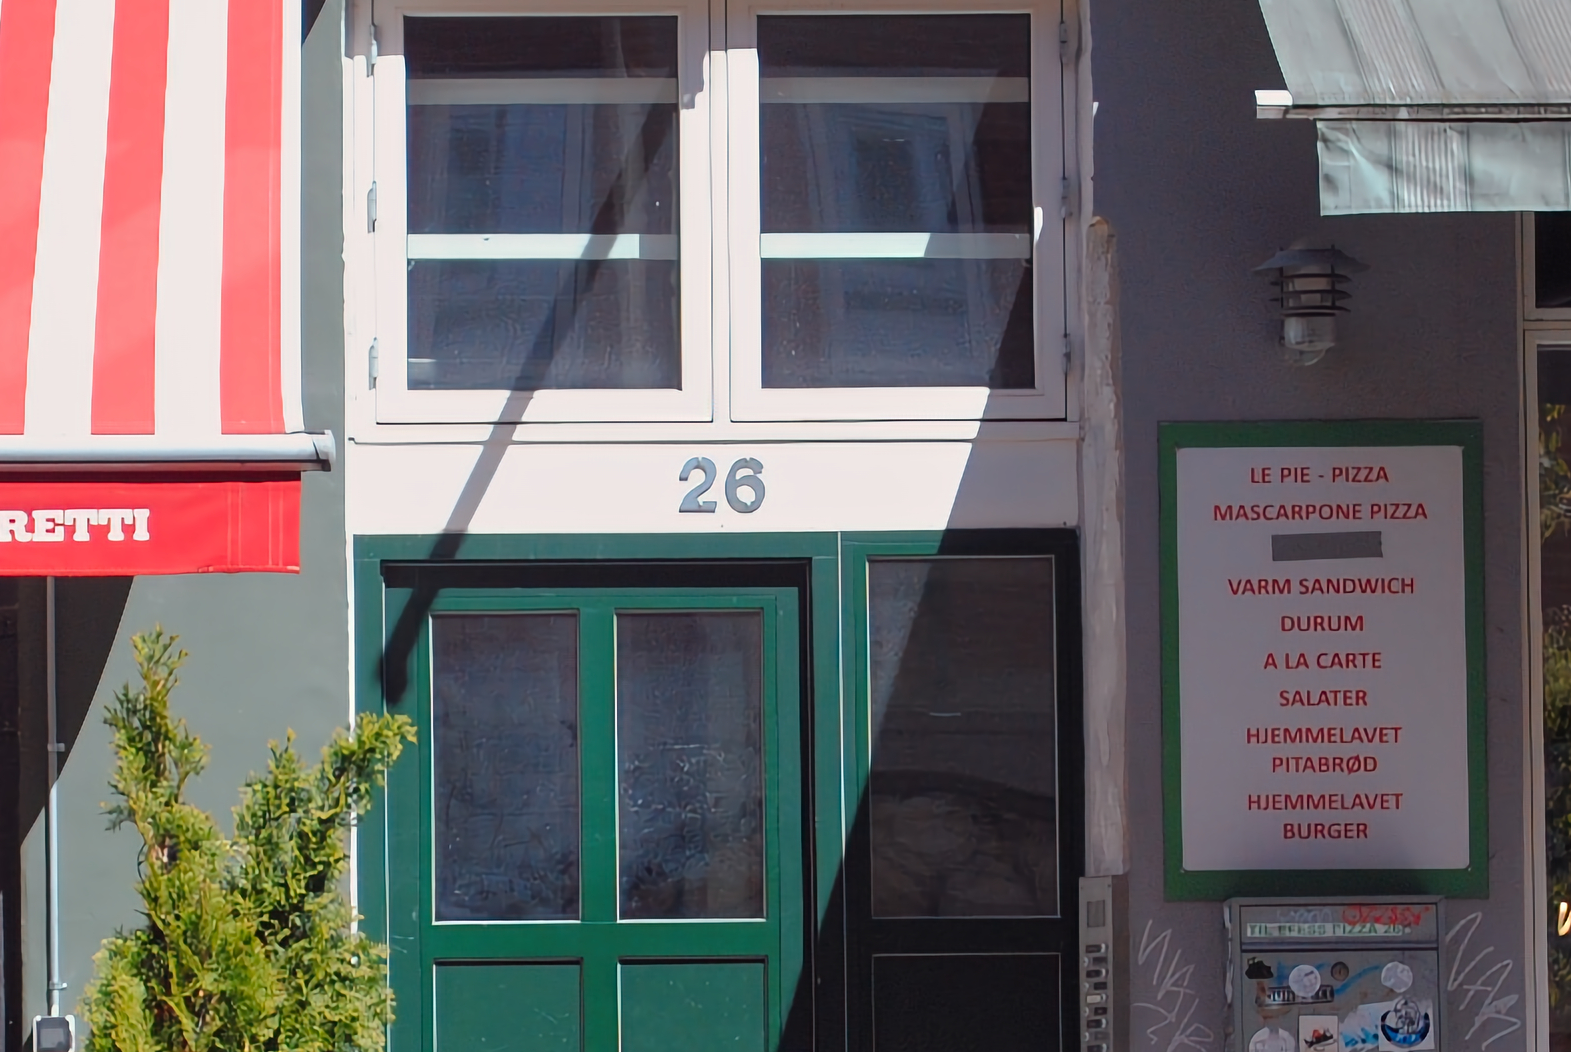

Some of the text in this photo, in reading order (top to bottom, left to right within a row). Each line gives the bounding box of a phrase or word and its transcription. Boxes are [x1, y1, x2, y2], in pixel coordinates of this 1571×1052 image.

[678, 456, 766, 513] 26
[1250, 467, 1272, 485] LE
[1280, 466, 1311, 485] PIE
[1331, 465, 1390, 484] PIZZA
[1213, 501, 1428, 522] MASCARPONE PIZZA
[1227, 575, 1415, 597] VARM SANDWICH
[1279, 613, 1365, 634] DURUM
[1263, 651, 1383, 671] A LA CARTE
[1279, 688, 1369, 708] SALATER
[1245, 725, 1404, 746] HJEMMELAVET
[1271, 754, 1379, 776] PITABRØD
[1246, 792, 1405, 812] HJEMMELAVET
[1282, 820, 1370, 840] BURGER
